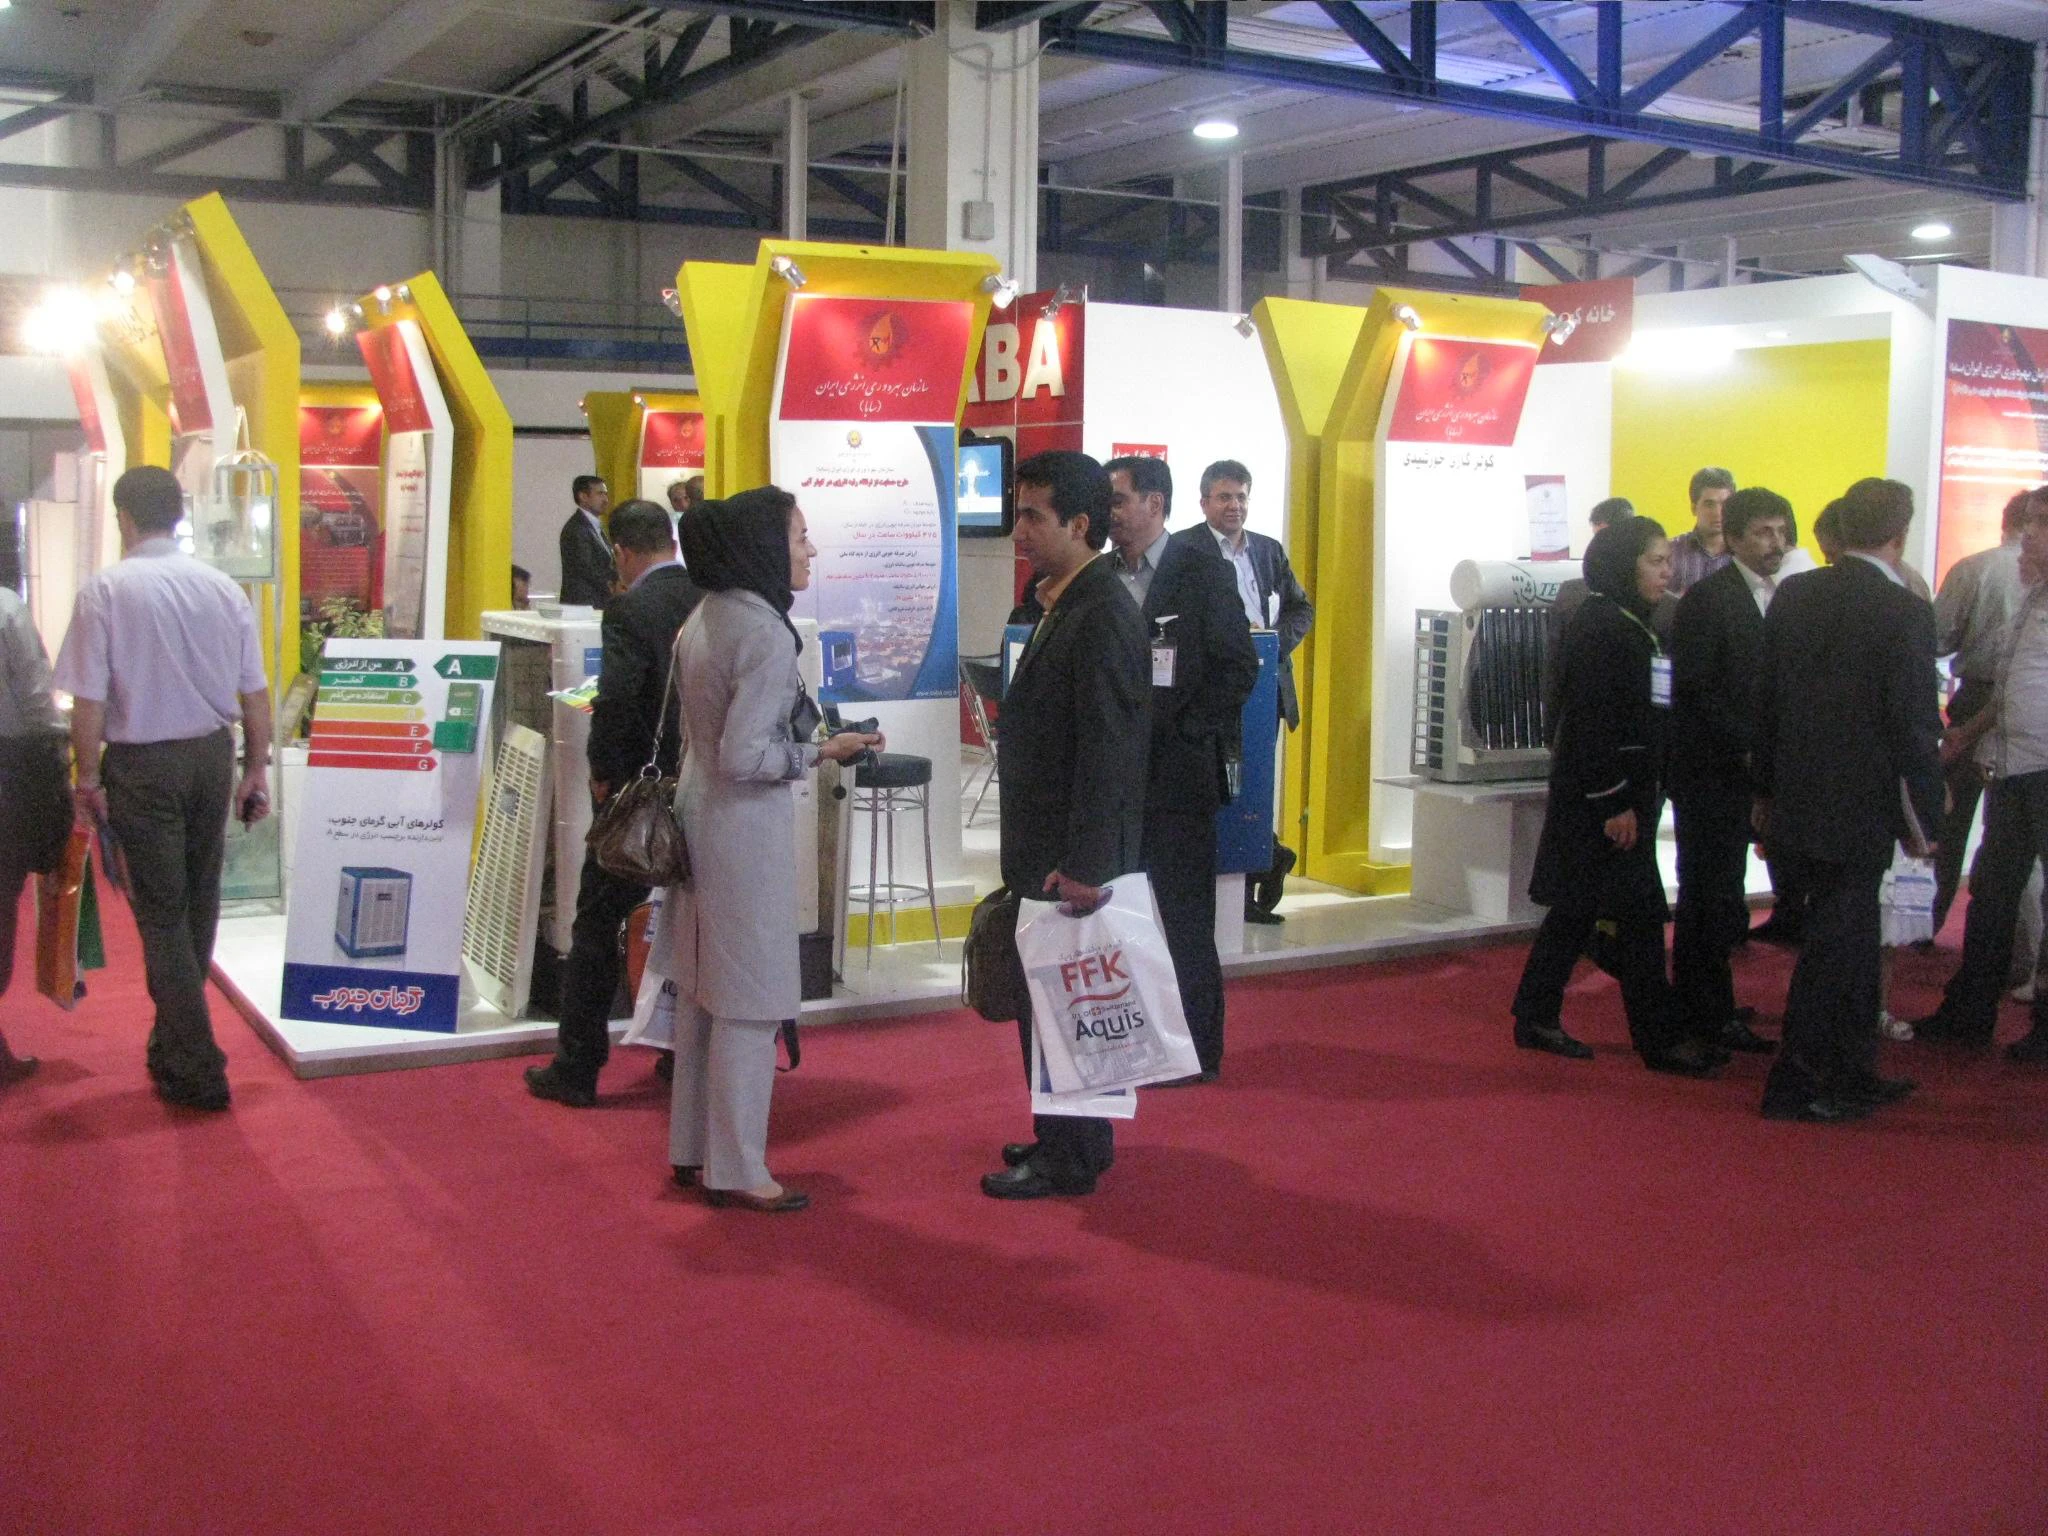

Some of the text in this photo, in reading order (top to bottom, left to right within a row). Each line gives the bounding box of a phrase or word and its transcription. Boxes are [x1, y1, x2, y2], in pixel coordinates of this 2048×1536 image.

[815, 380, 840, 397] ایران
[838, 373, 866, 396] انرژی
[901, 379, 928, 397] سازمان
[395, 660, 405, 672] A
[446, 659, 463, 676] A
[399, 676, 409, 687] B
[402, 693, 412, 704] C
[410, 726, 419, 737] E
[414, 742, 423, 753] F
[418, 759, 429, 770] G
[387, 816, 405, 829] آبی
[406, 819, 444, 831] کولرهای
[1060, 950, 1129, 993] FFK
[312, 986, 425, 1015] گرمای جنوب
[1076, 1008, 1145, 1041] Aquis
